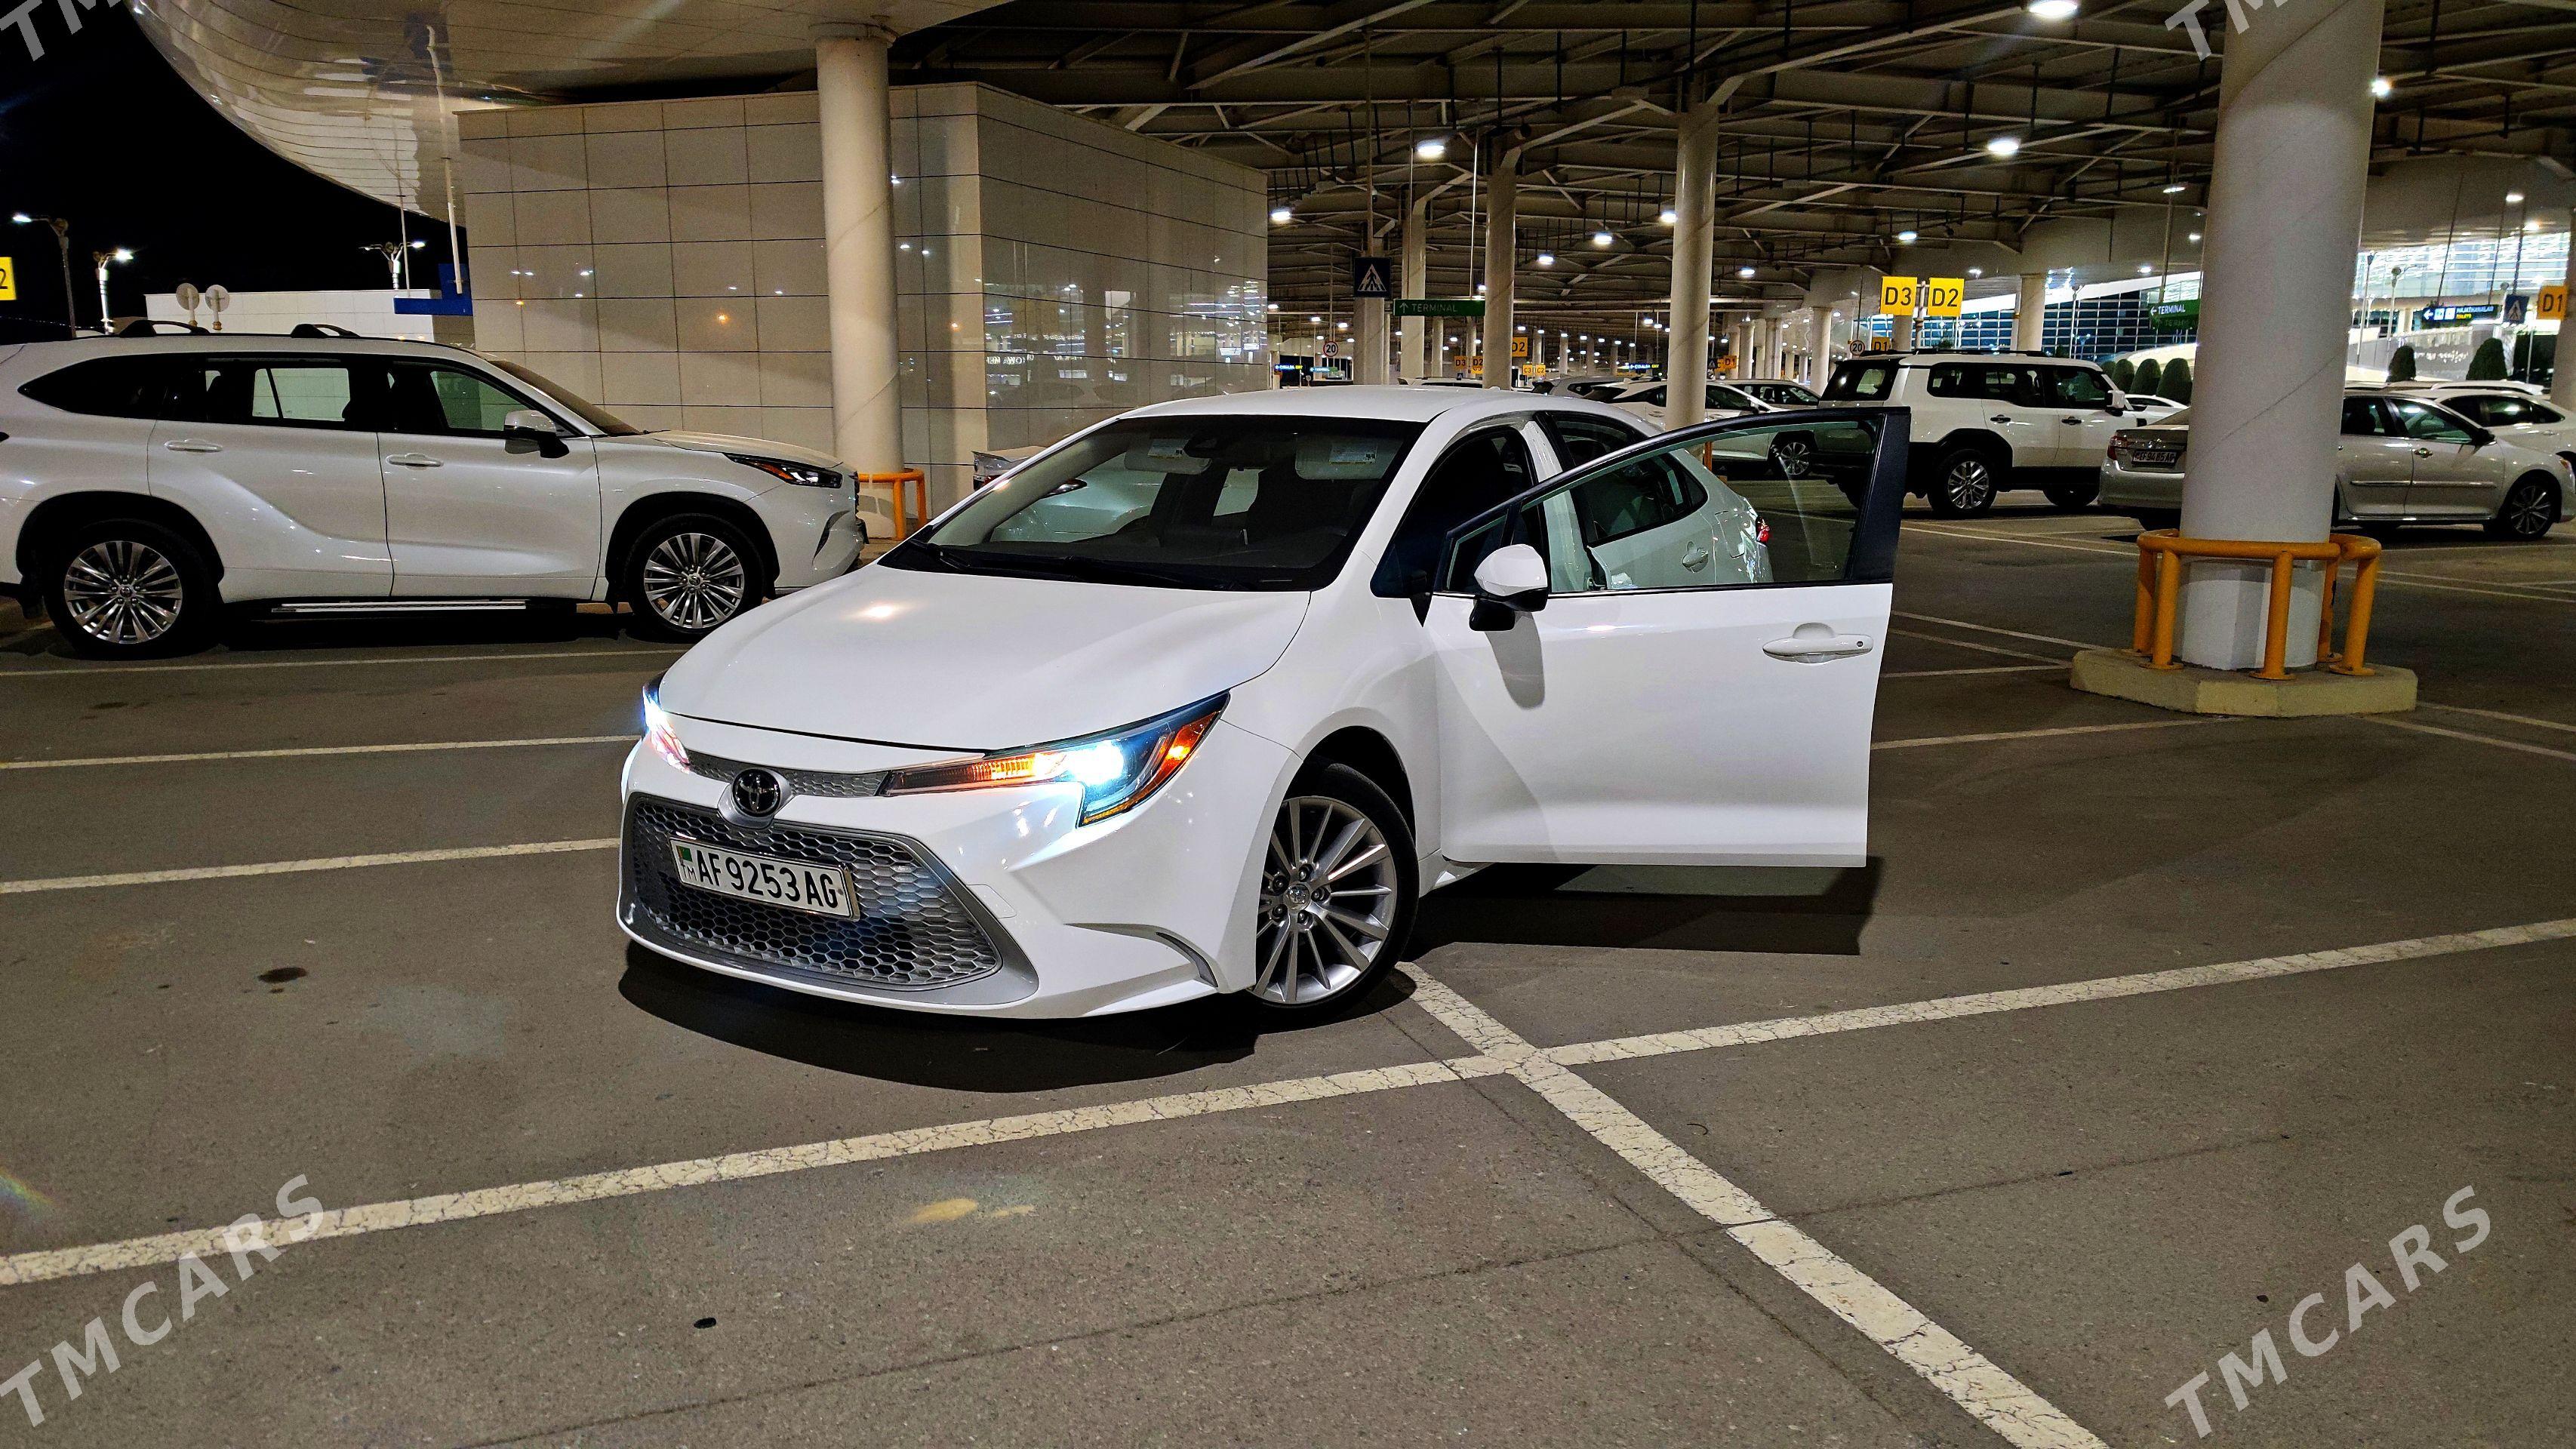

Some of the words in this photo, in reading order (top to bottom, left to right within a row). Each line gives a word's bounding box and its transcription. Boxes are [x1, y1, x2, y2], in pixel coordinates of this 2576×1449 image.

[1885, 287, 1912, 306] D3
[1931, 288, 1959, 307] D2
[1411, 303, 1457, 313] TERMINAL
[2542, 294, 2563, 312] D1
[2158, 304, 2186, 315] TERMINAL
[1325, 344, 1336, 353] 20
[1512, 341, 1526, 352] D2
[1851, 343, 1862, 352] 20
[1873, 341, 1888, 352] D1
[1455, 358, 1467, 367] D3
[1473, 358, 1484, 366] D2
[681, 863, 697, 881] TM
